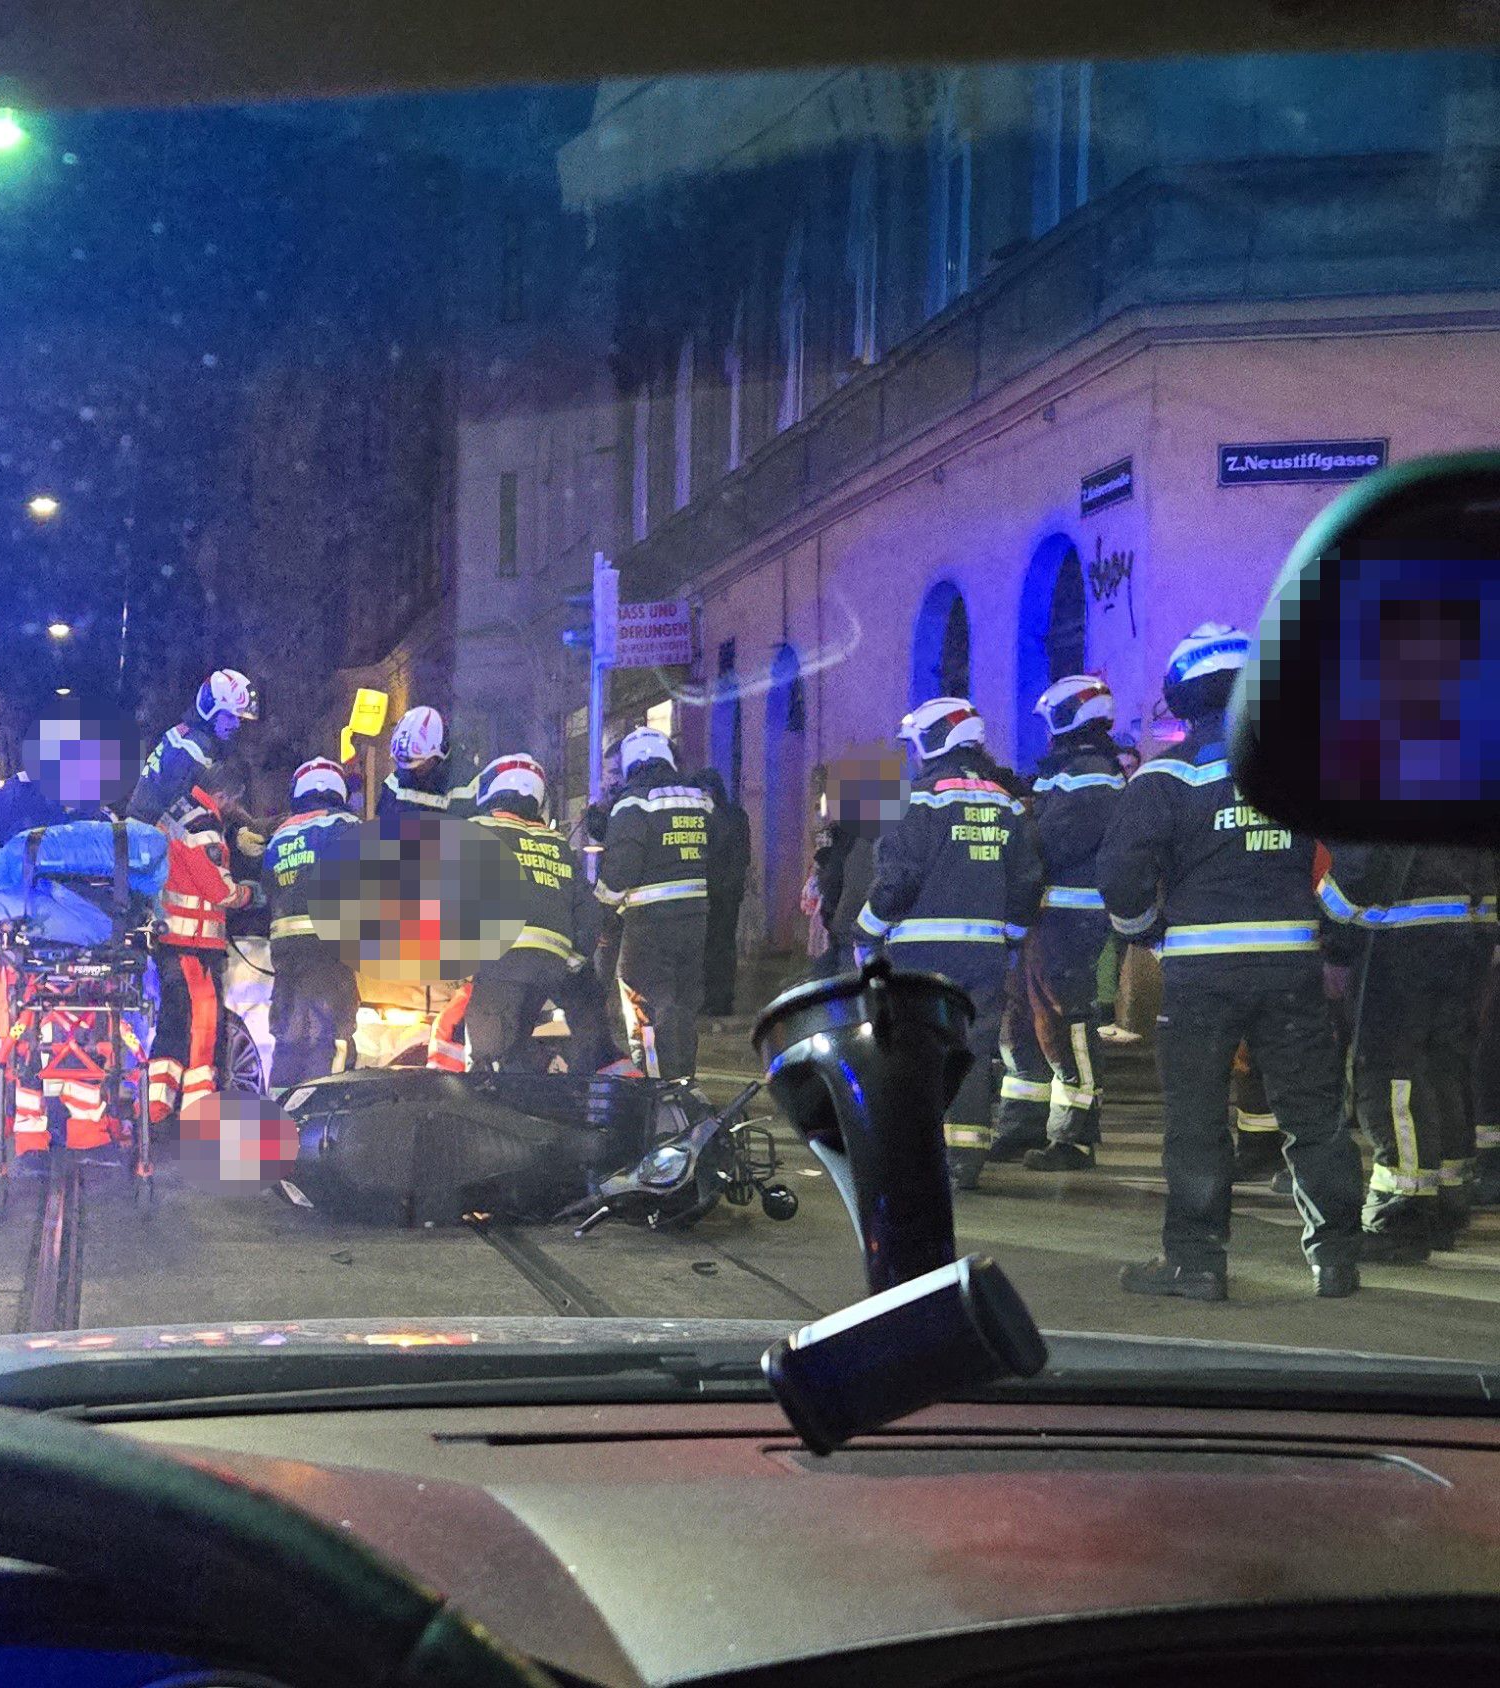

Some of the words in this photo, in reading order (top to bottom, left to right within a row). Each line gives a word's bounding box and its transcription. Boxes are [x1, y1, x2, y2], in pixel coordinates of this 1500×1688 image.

[650, 603, 678, 619] UND
[1245, 829, 1292, 852] WIEN
[969, 844, 1000, 861] WIEN
